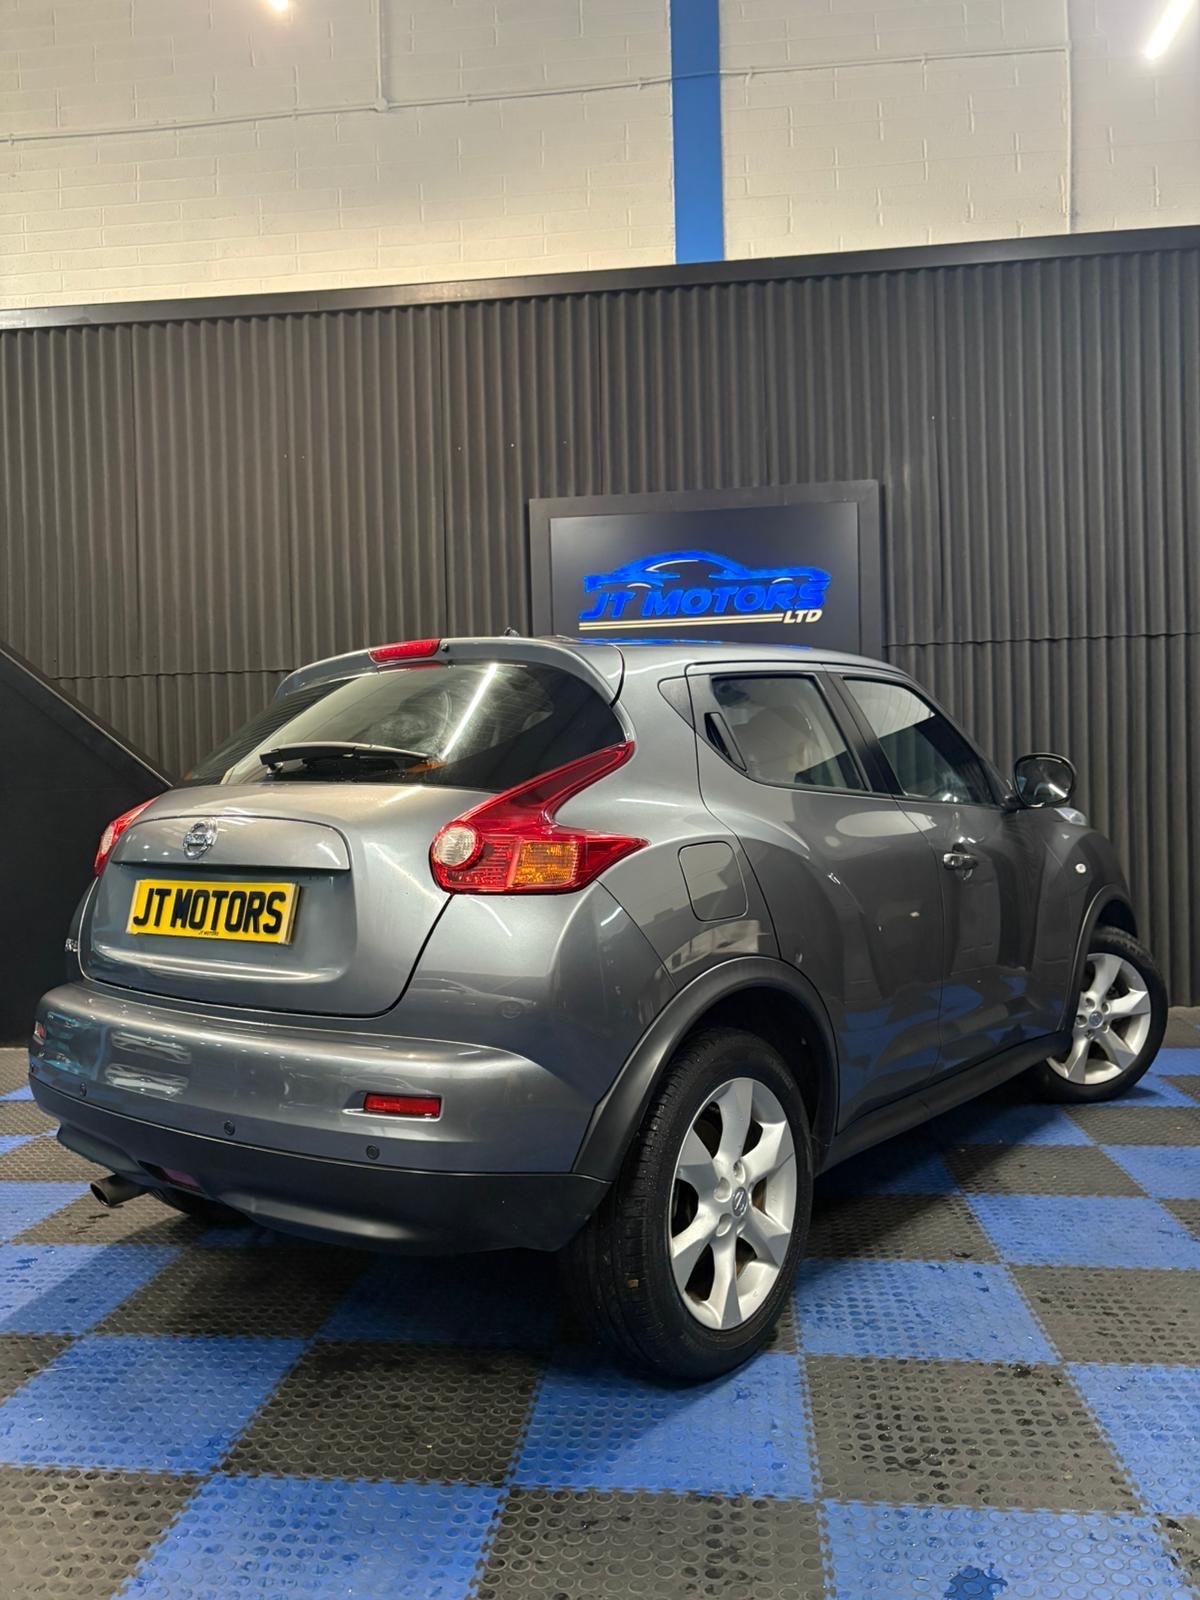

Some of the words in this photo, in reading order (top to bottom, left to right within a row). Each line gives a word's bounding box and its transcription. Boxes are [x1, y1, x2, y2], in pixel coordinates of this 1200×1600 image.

[578, 591, 636, 619] JT
[640, 581, 828, 618] MOTORS
[783, 609, 823, 624] LTD
[133, 888, 172, 928] JT
[170, 888, 287, 934] MOTORS
